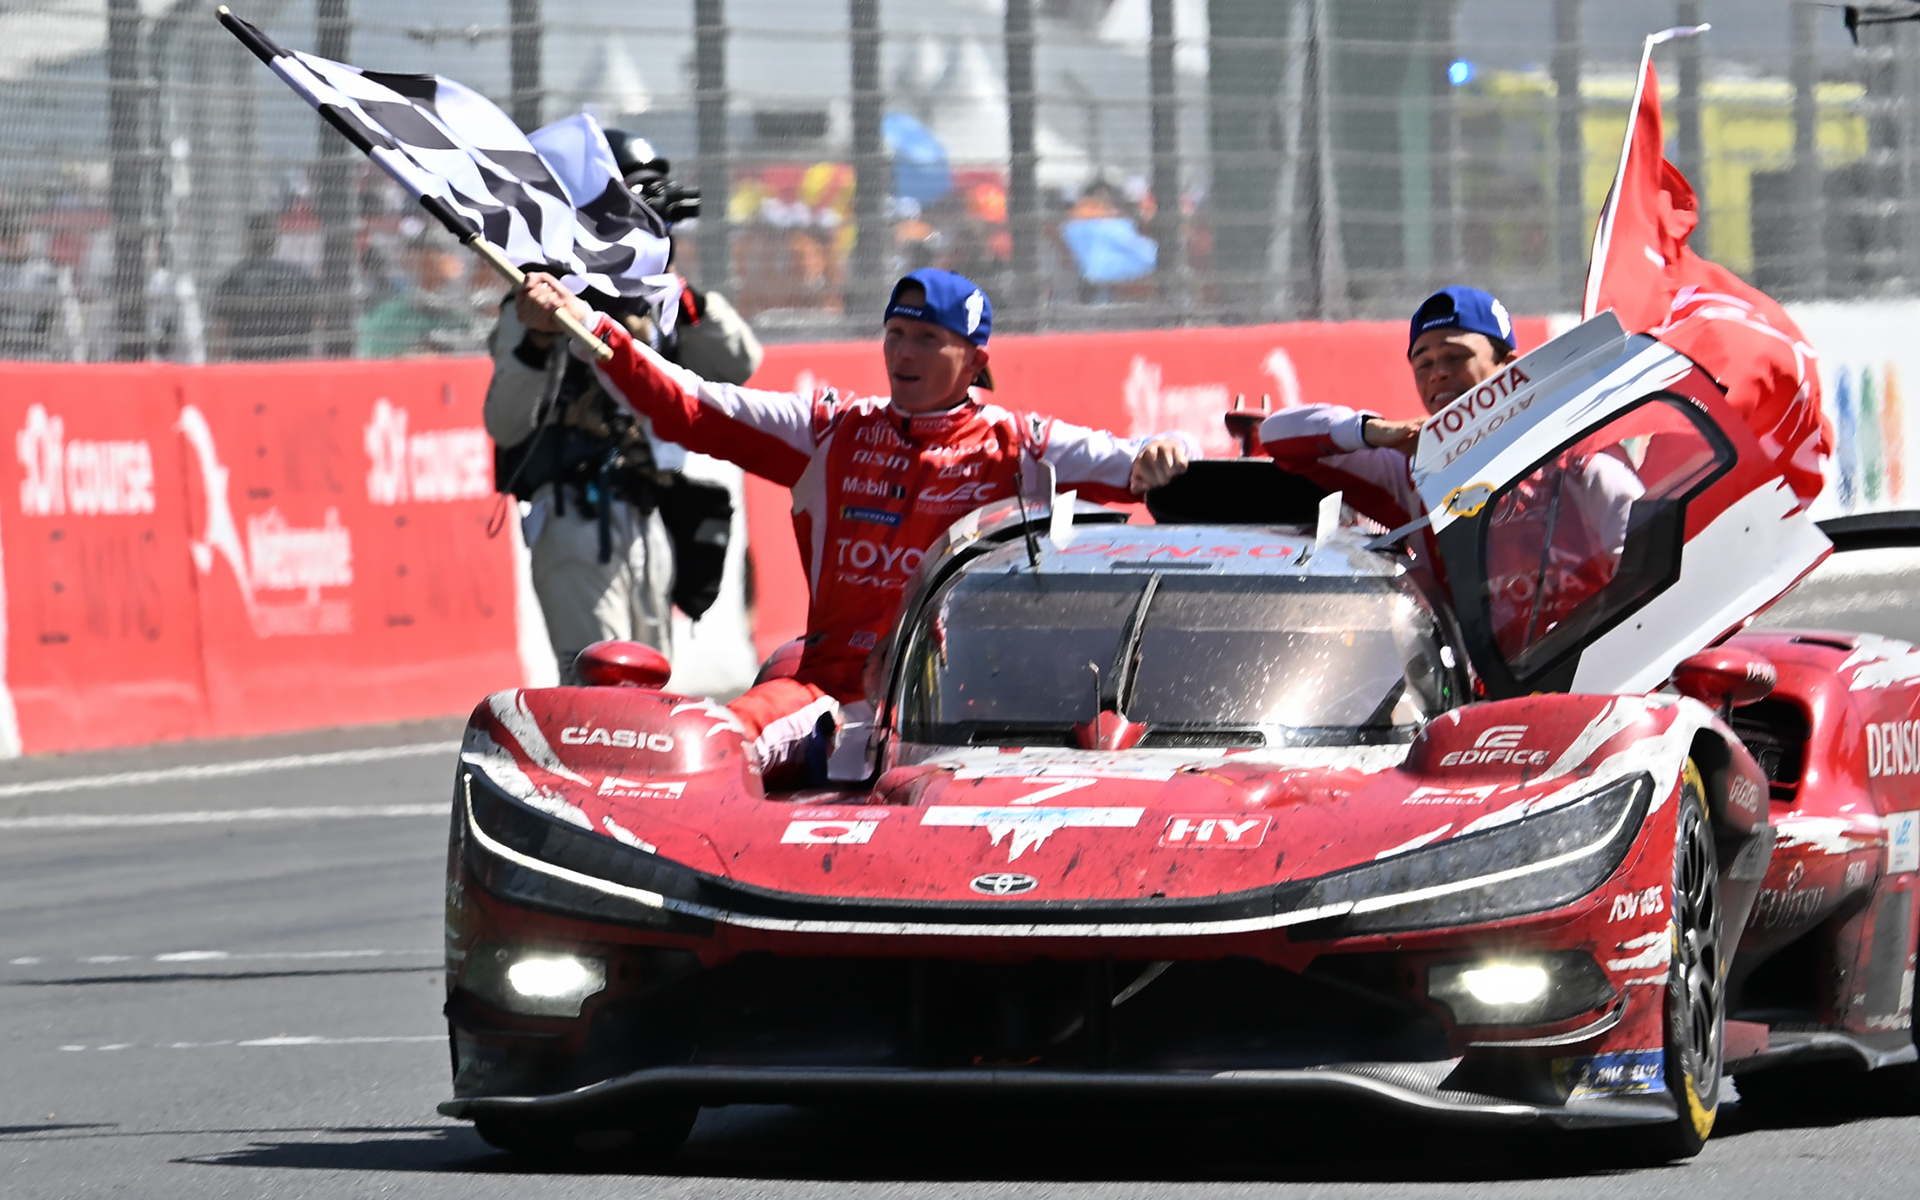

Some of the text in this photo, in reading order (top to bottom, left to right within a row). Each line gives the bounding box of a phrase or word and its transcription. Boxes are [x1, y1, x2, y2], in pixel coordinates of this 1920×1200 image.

[1427, 366, 1531, 443] TOYOTA
[842, 476, 888, 497] Mobil
[918, 481, 998, 502] WEC
[837, 538, 926, 576] TOYO
[561, 726, 674, 753] CASIO
[1865, 718, 1920, 779] DENSO
[1439, 749, 1551, 767] EDIFICE
[1008, 776, 1099, 805] 7
[1167, 818, 1261, 843] HY
[1594, 1062, 1660, 1085] MICELIN
